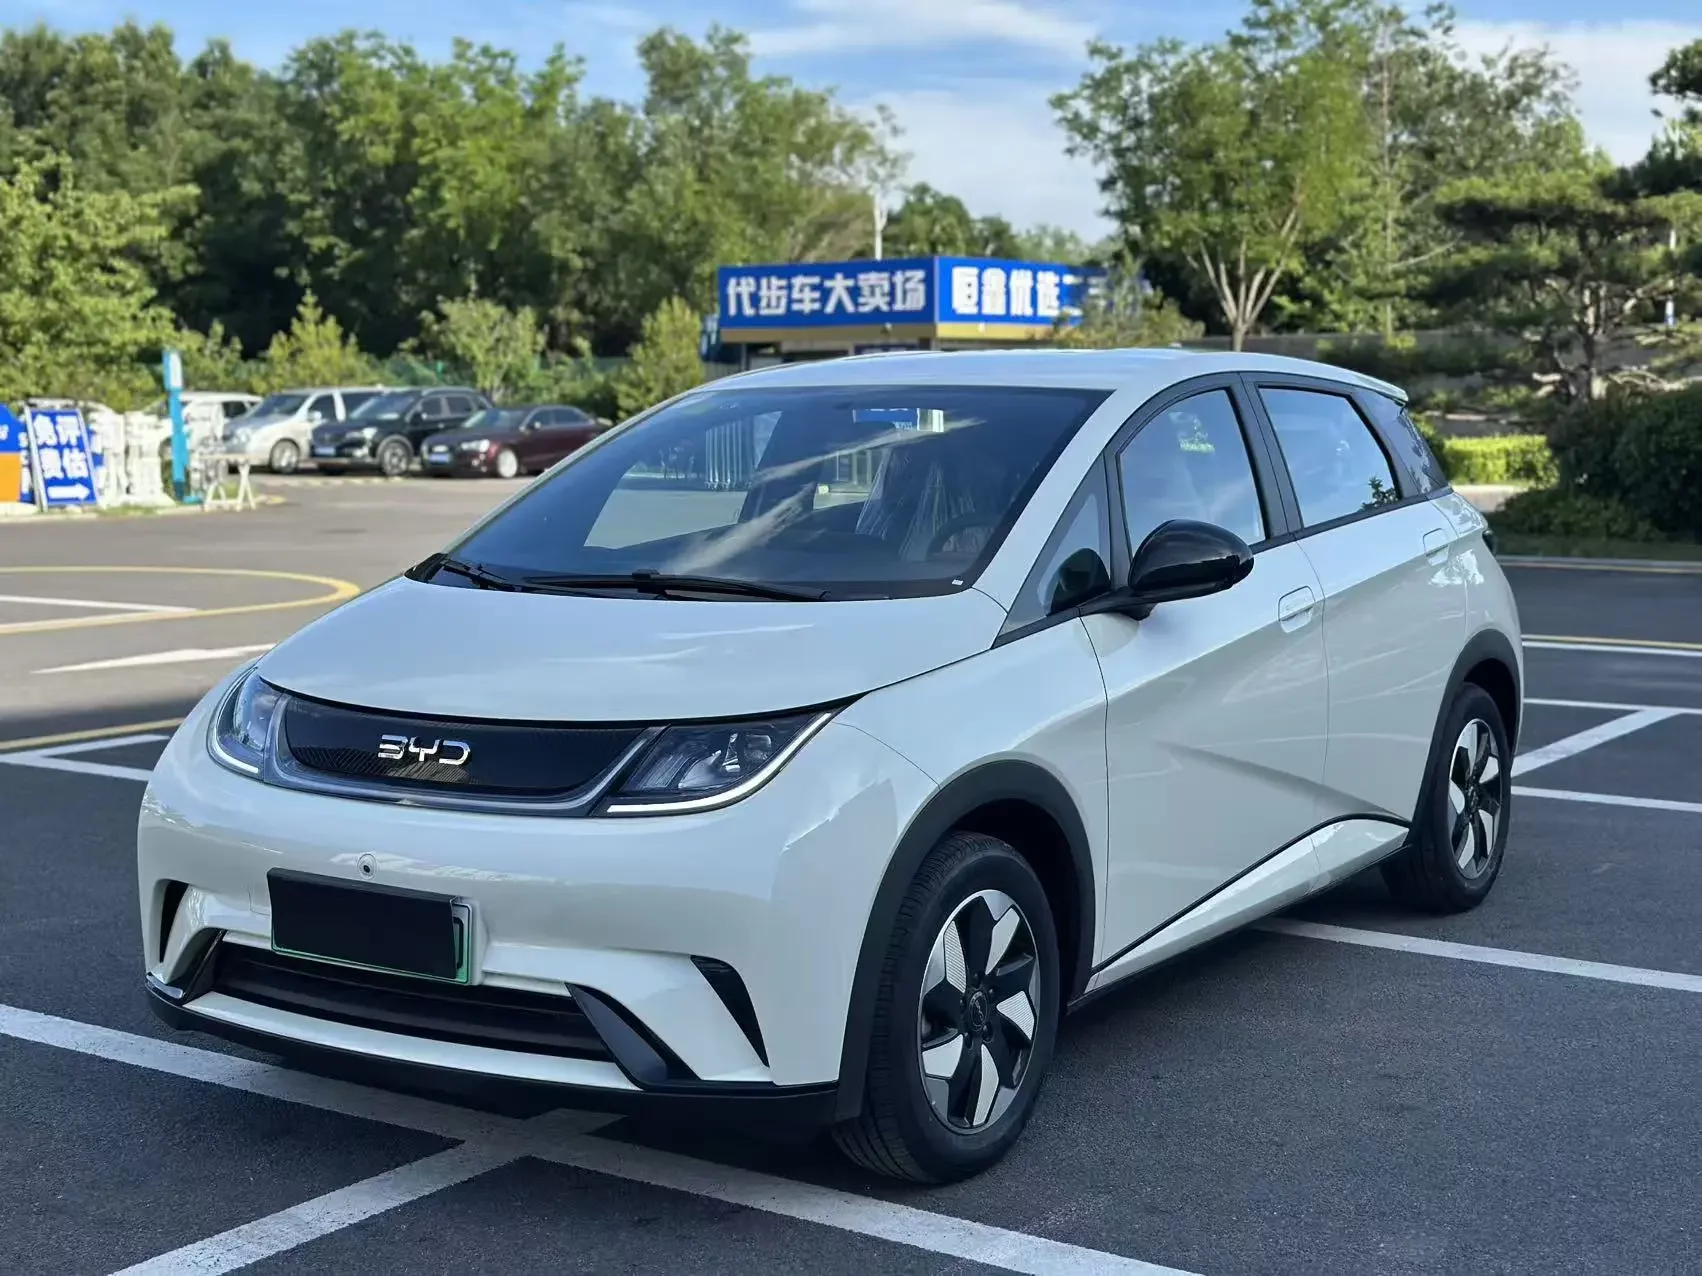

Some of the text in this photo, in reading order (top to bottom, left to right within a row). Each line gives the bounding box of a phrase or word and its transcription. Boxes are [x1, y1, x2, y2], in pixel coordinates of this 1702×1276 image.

[727, 269, 926, 317] 代步车大卖场
[378, 734, 471, 765] BYD
